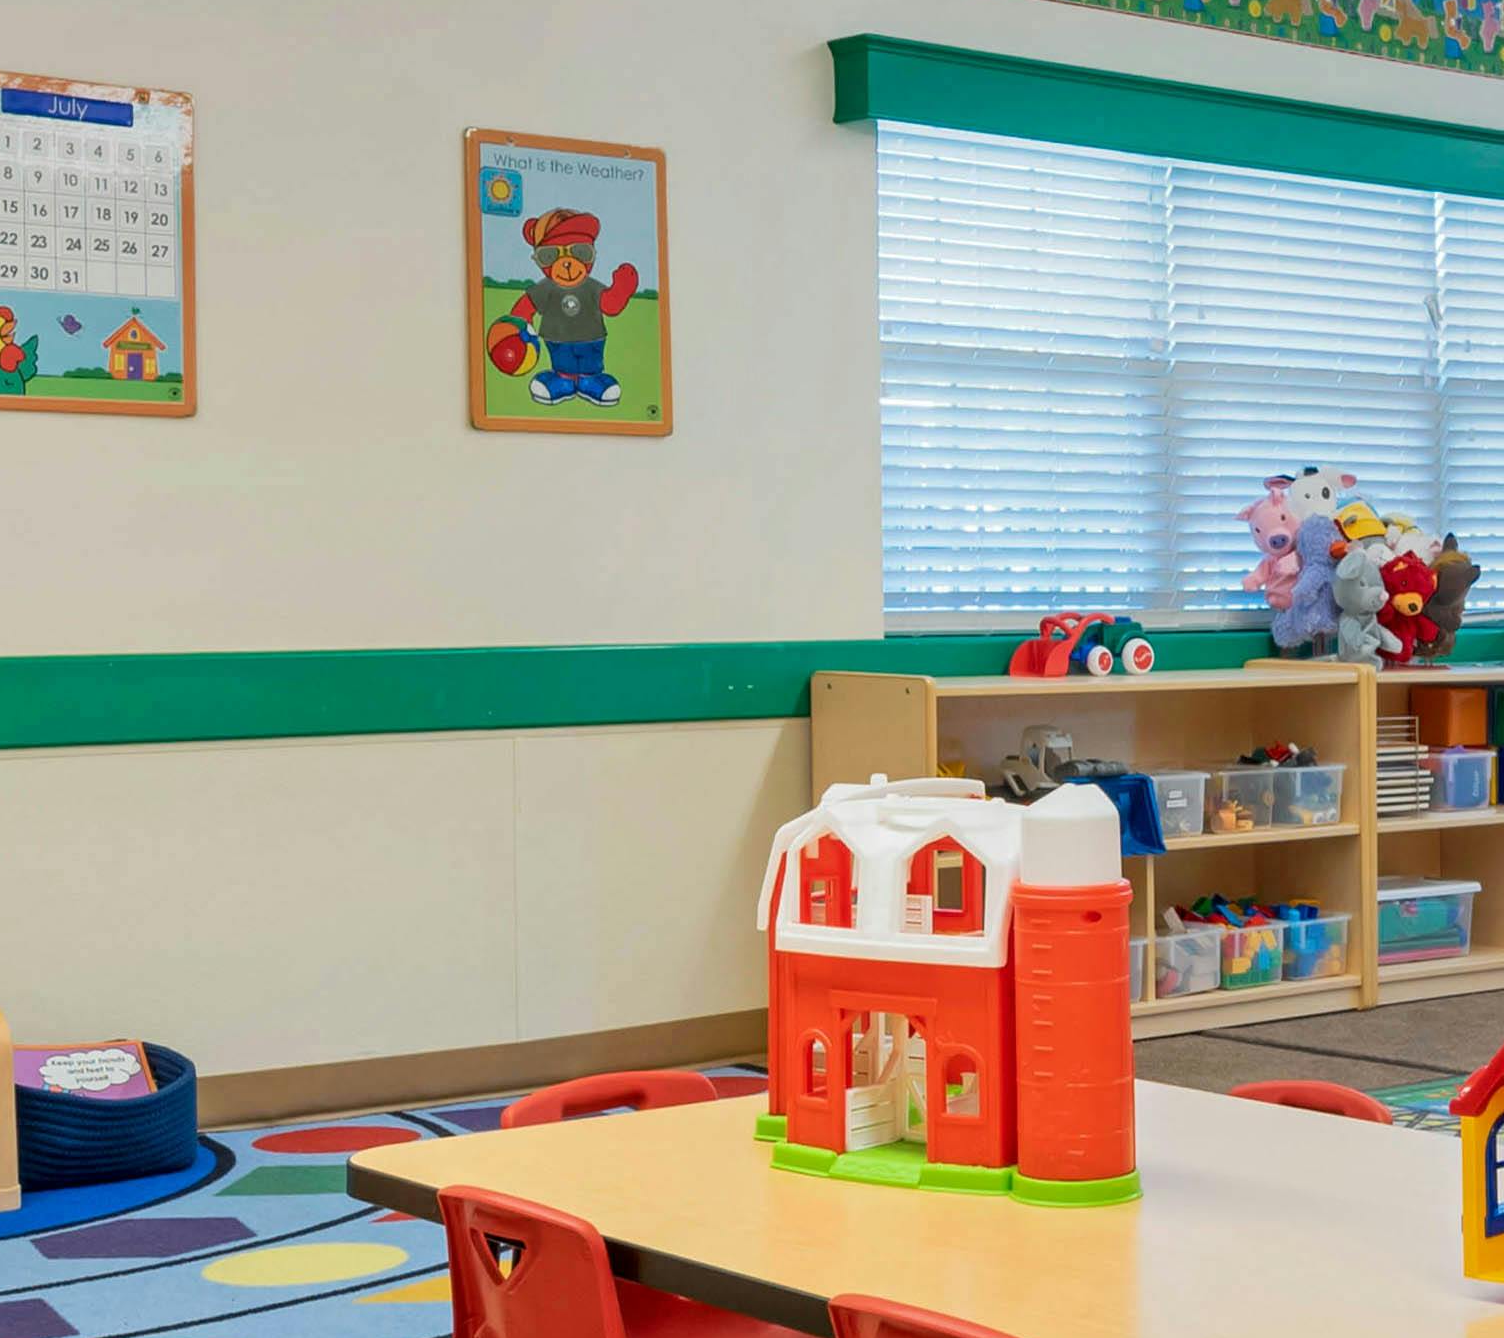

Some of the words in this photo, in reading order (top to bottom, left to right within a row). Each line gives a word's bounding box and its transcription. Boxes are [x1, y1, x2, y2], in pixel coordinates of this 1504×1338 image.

[48, 96, 88, 121] July
[32, 137, 42, 151] 2
[66, 142, 75, 156] 3
[94, 145, 103, 159] 4
[126, 149, 135, 162] 5
[154, 150, 163, 163] 6
[493, 153, 533, 171] What
[536, 157, 546, 172] is
[550, 160, 573, 175] the
[577, 163, 645, 182] Weather?
[3, 166, 13, 180] 8
[34, 171, 42, 183] 9
[63, 172, 78, 187] 10
[96, 177, 108, 191] 11
[124, 180, 138, 194] 12
[154, 182, 168, 197] 13
[2, 200, 18, 214] 15
[32, 204, 48, 218] 16
[64, 206, 79, 219] 17
[96, 207, 112, 221] 18
[124, 211, 139, 224] 19
[151, 213, 169, 227] 20
[0, 232, 18, 246] 22
[30, 235, 47, 249] 23
[65, 237, 82, 251] 24
[94, 238, 110, 252] 25
[121, 241, 138, 255] 26
[151, 245, 169, 258] 27
[0, 264, 18, 278] 29
[30, 266, 49, 280] 30
[63, 271, 79, 284] 31
